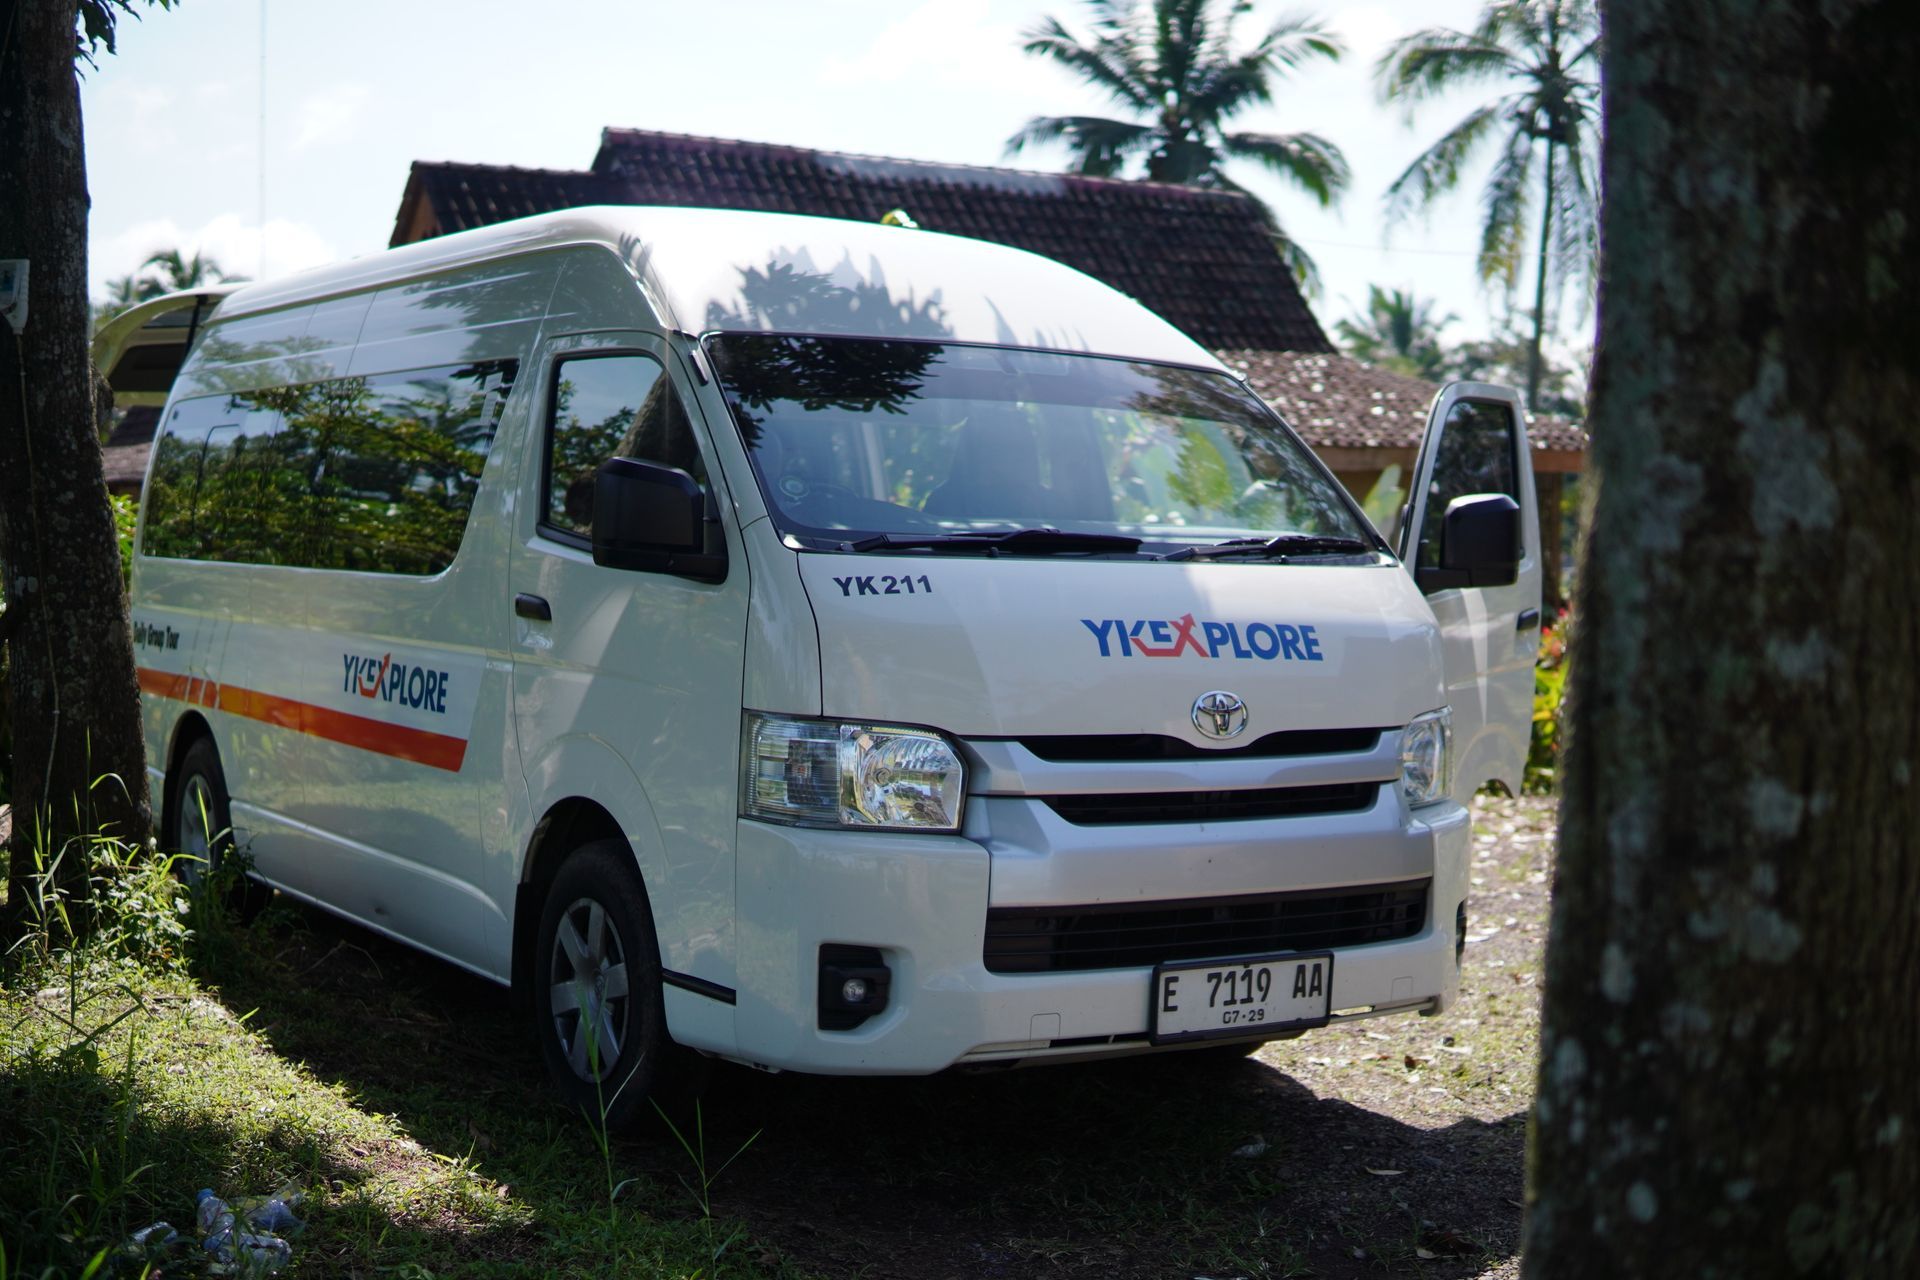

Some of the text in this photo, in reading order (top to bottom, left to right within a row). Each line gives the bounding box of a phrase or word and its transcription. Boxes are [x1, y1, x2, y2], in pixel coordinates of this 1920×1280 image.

[832, 575, 932, 596] YK211
[147, 622, 165, 652] Group
[166, 625, 180, 650] Tour
[1080, 613, 1323, 661] YKEXPLORE
[343, 653, 449, 714] YKEXPLORE
[1163, 963, 1323, 1013] E 7119 AA
